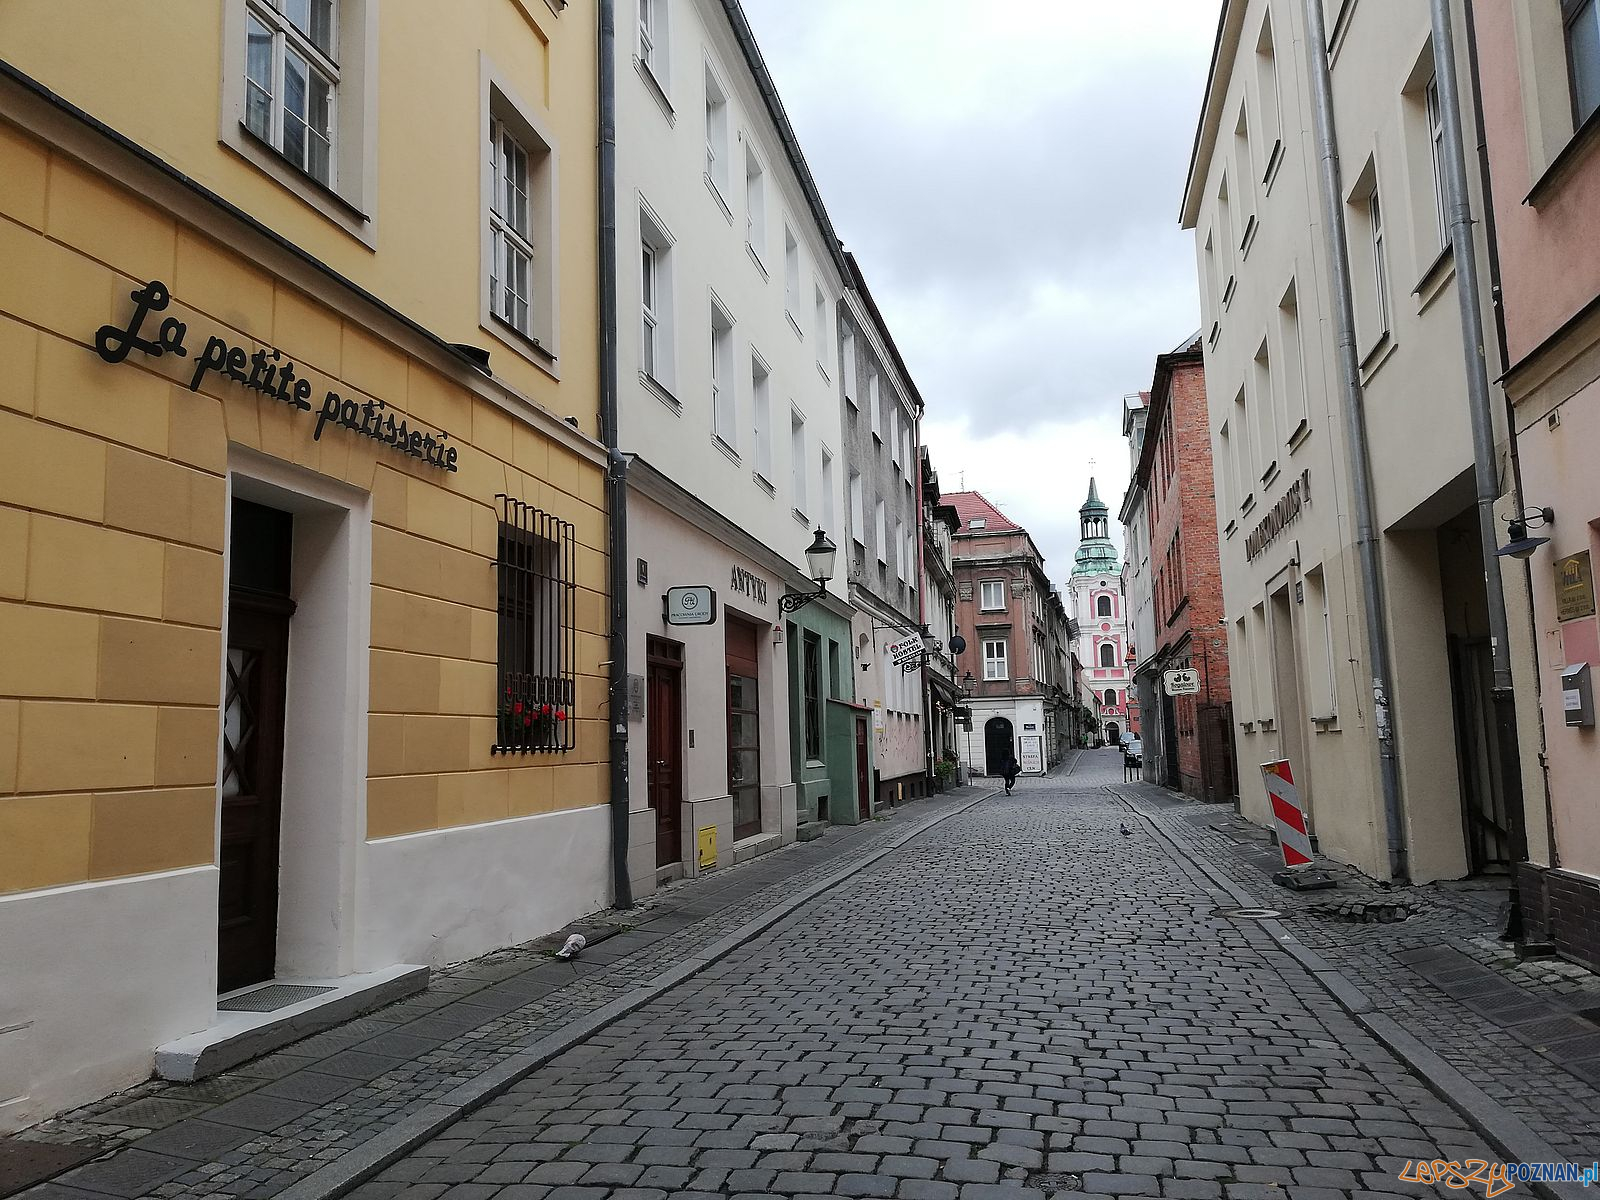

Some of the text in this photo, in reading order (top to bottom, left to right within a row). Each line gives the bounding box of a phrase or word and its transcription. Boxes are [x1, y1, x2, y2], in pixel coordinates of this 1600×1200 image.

[95, 280, 459, 473] La petite patisserie
[730, 564, 768, 606] ANTYKI
[893, 644, 922, 660] HOSTEL
[899, 636, 918, 649] FOLK
